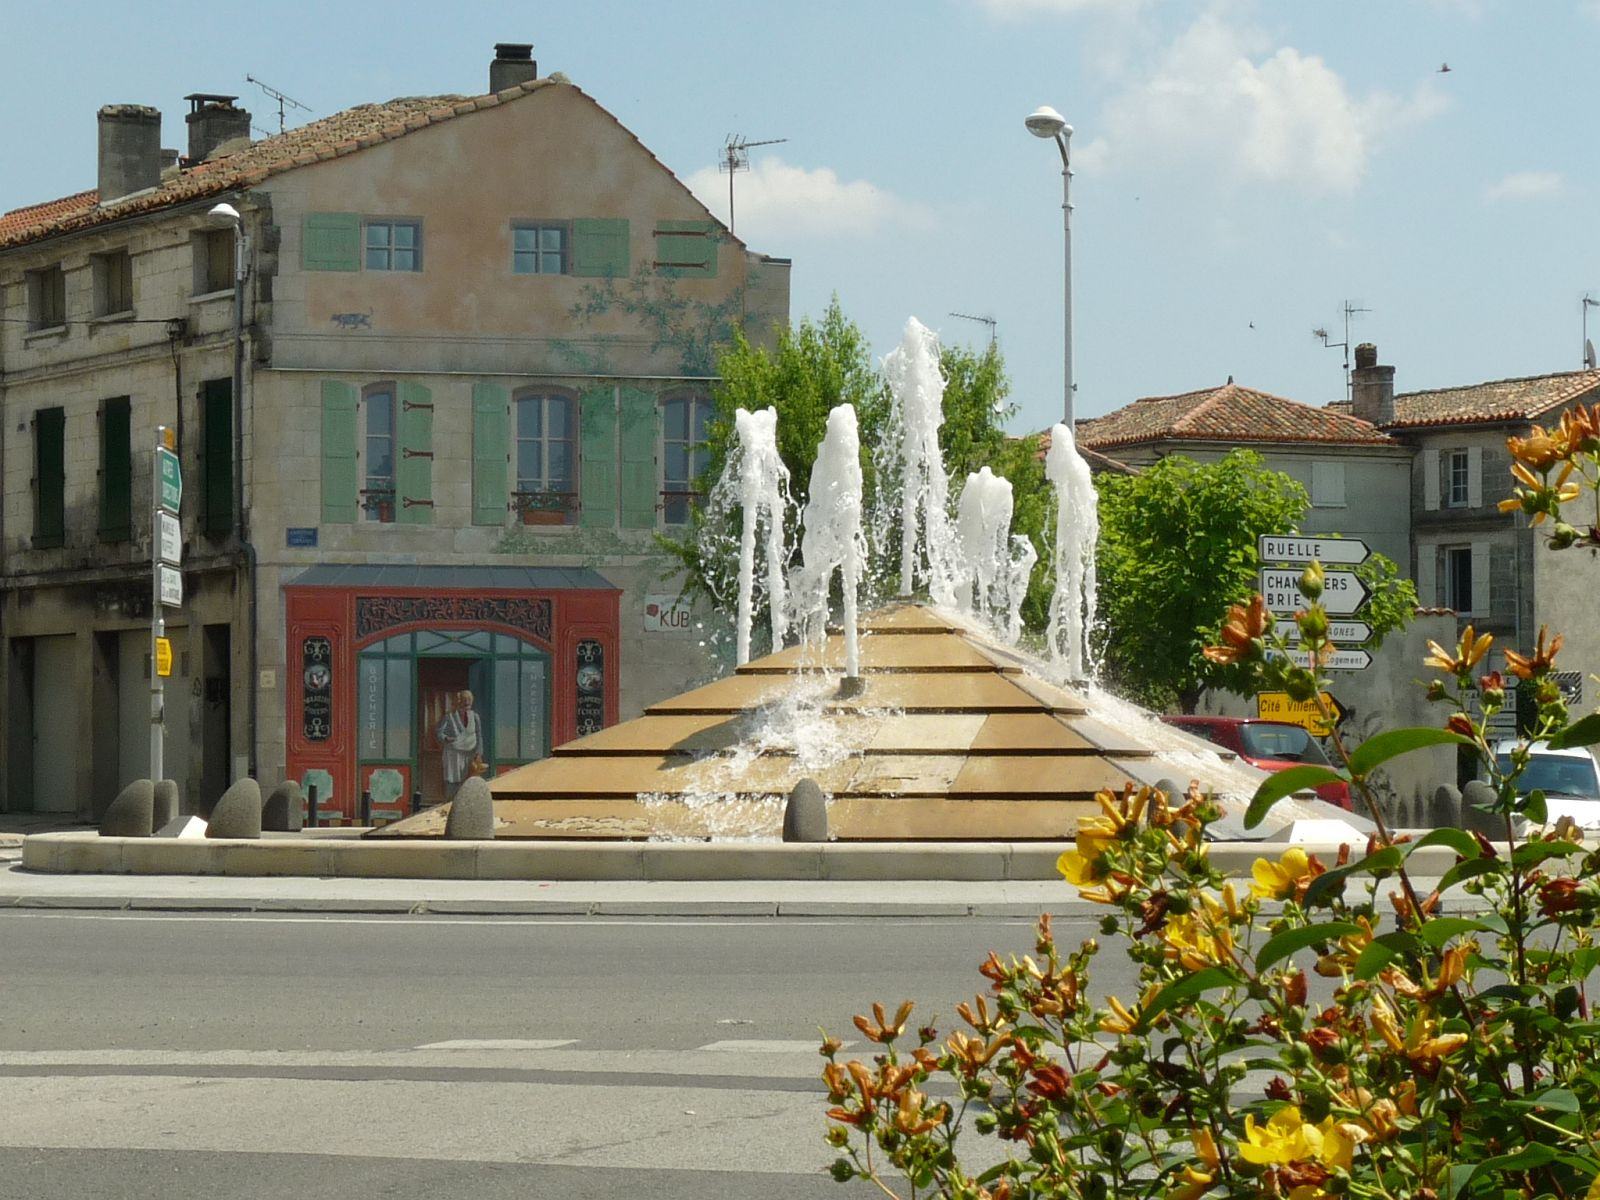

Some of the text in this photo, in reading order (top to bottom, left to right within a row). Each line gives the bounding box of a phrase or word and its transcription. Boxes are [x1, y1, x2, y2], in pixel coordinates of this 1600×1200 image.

[1267, 542, 1321, 557] RUELLE
[1267, 575, 1348, 590] CHAERS
[1267, 593, 1301, 606] BRIE
[660, 610, 690, 628] KUB
[369, 666, 377, 750] BOUCHERIE
[1260, 700, 1334, 713] Cité Villemt
